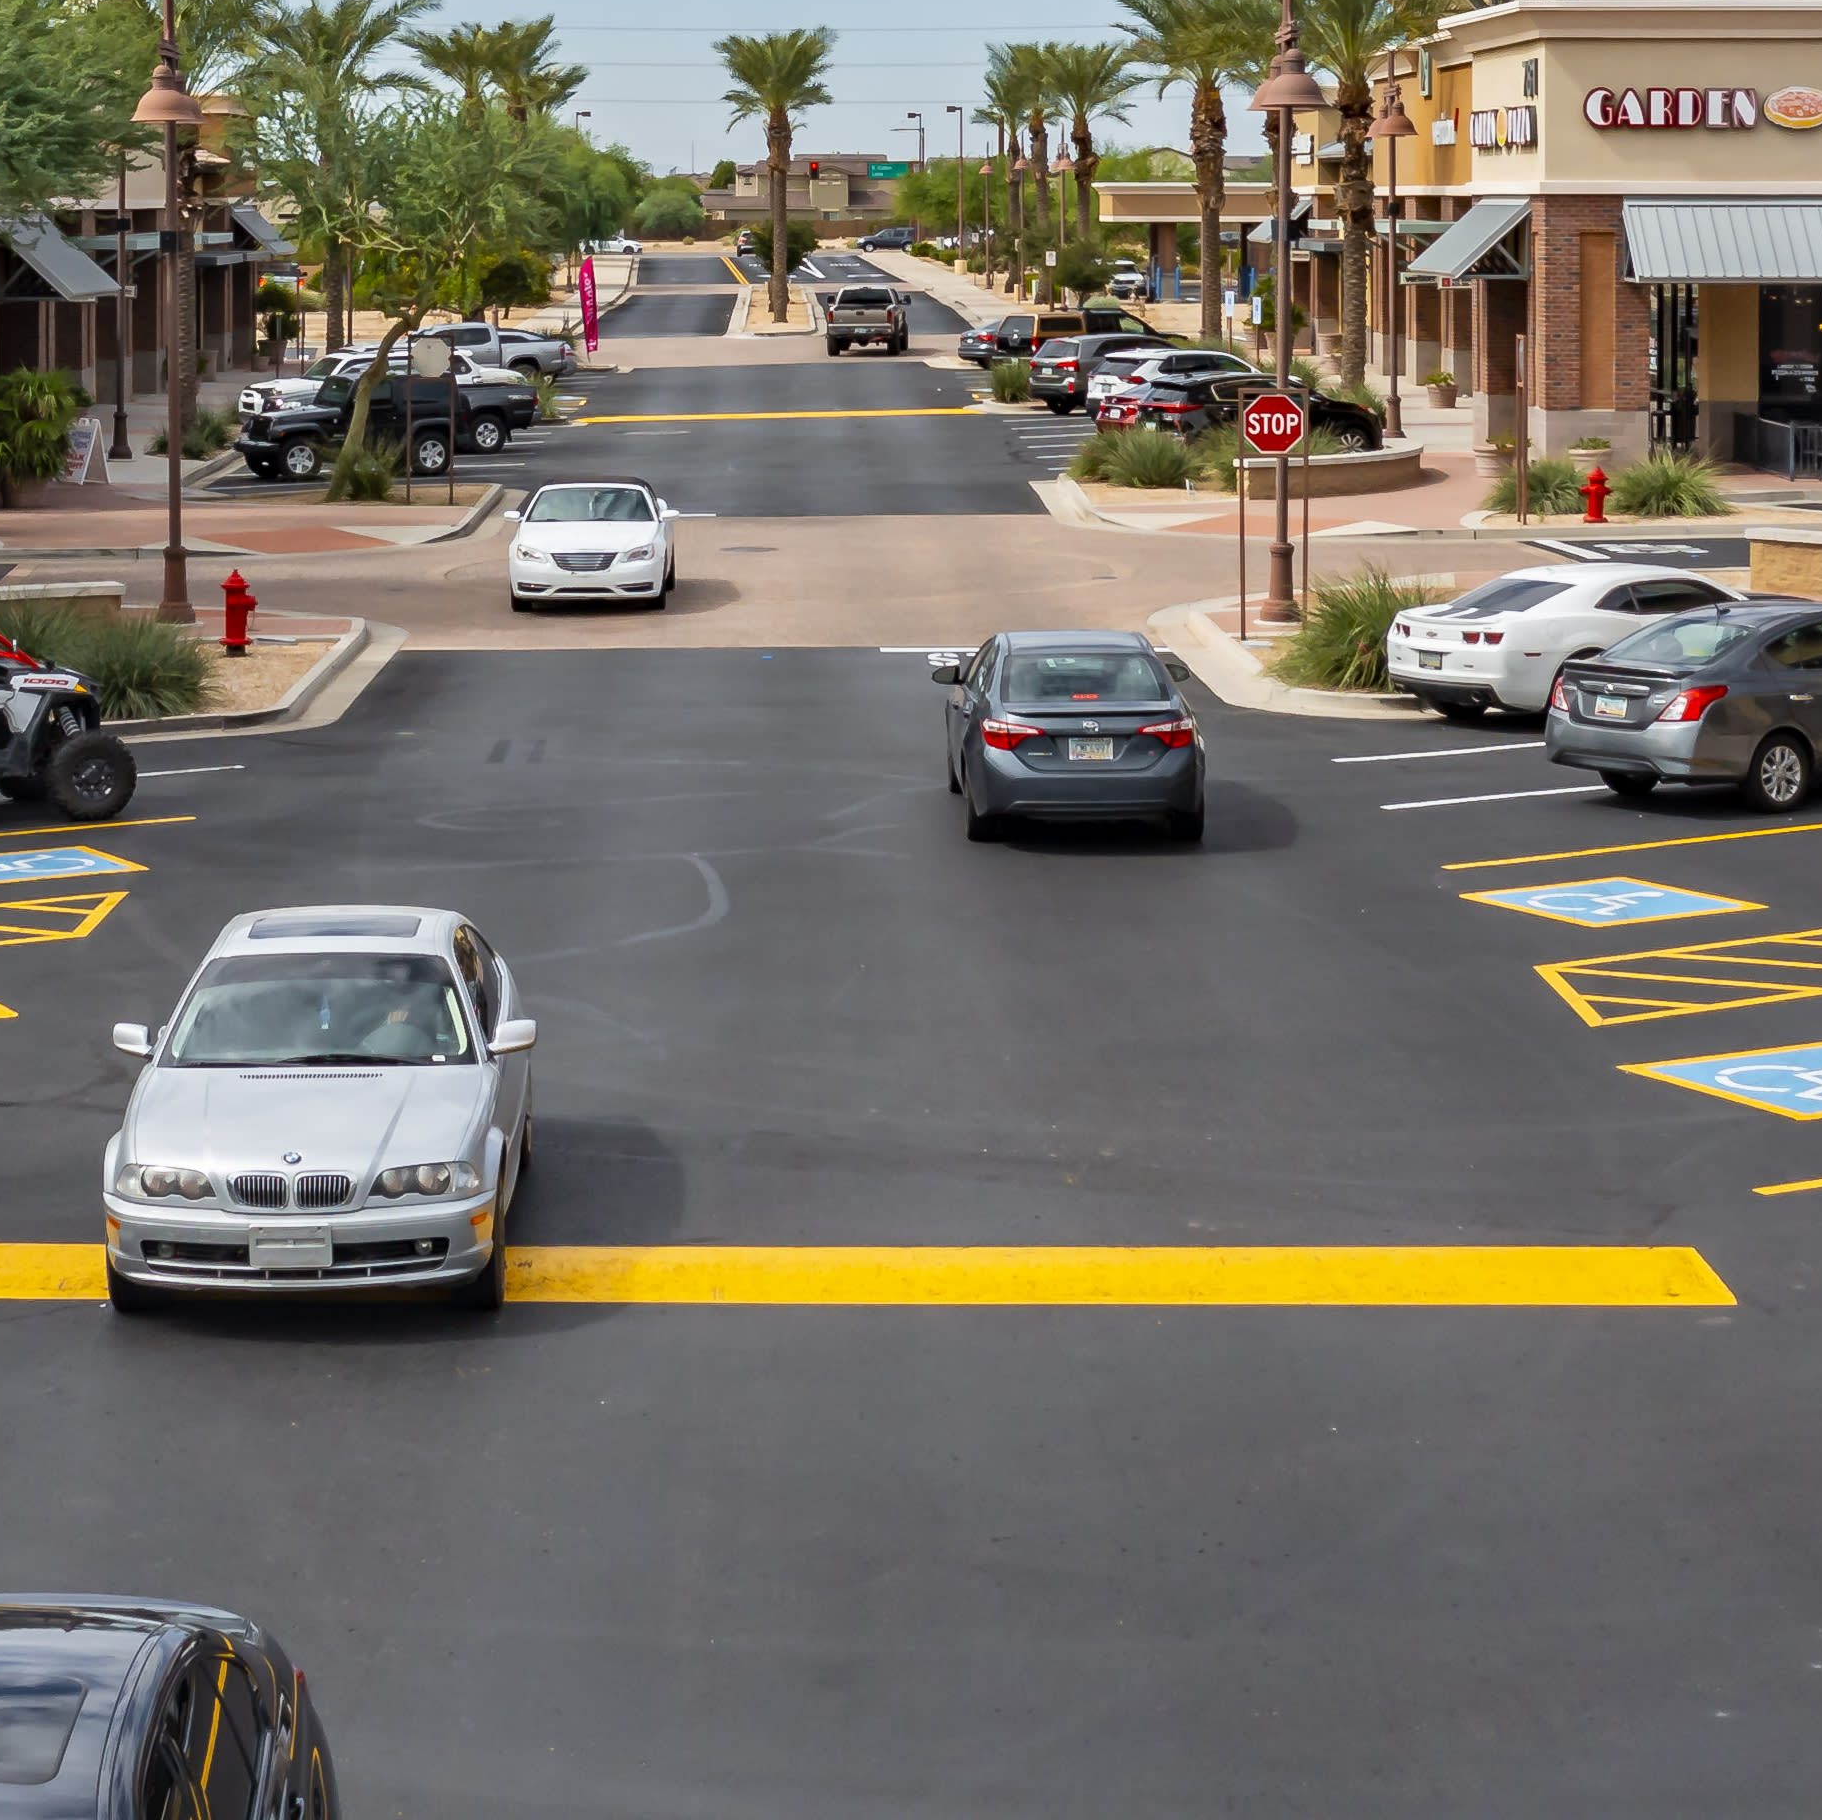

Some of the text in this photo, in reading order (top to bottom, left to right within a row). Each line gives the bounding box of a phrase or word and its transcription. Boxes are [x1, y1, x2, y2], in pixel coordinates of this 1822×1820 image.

[1583, 86, 1757, 130] GARDEN
[1247, 412, 1300, 436] STOP
[23, 677, 70, 687] 1000
